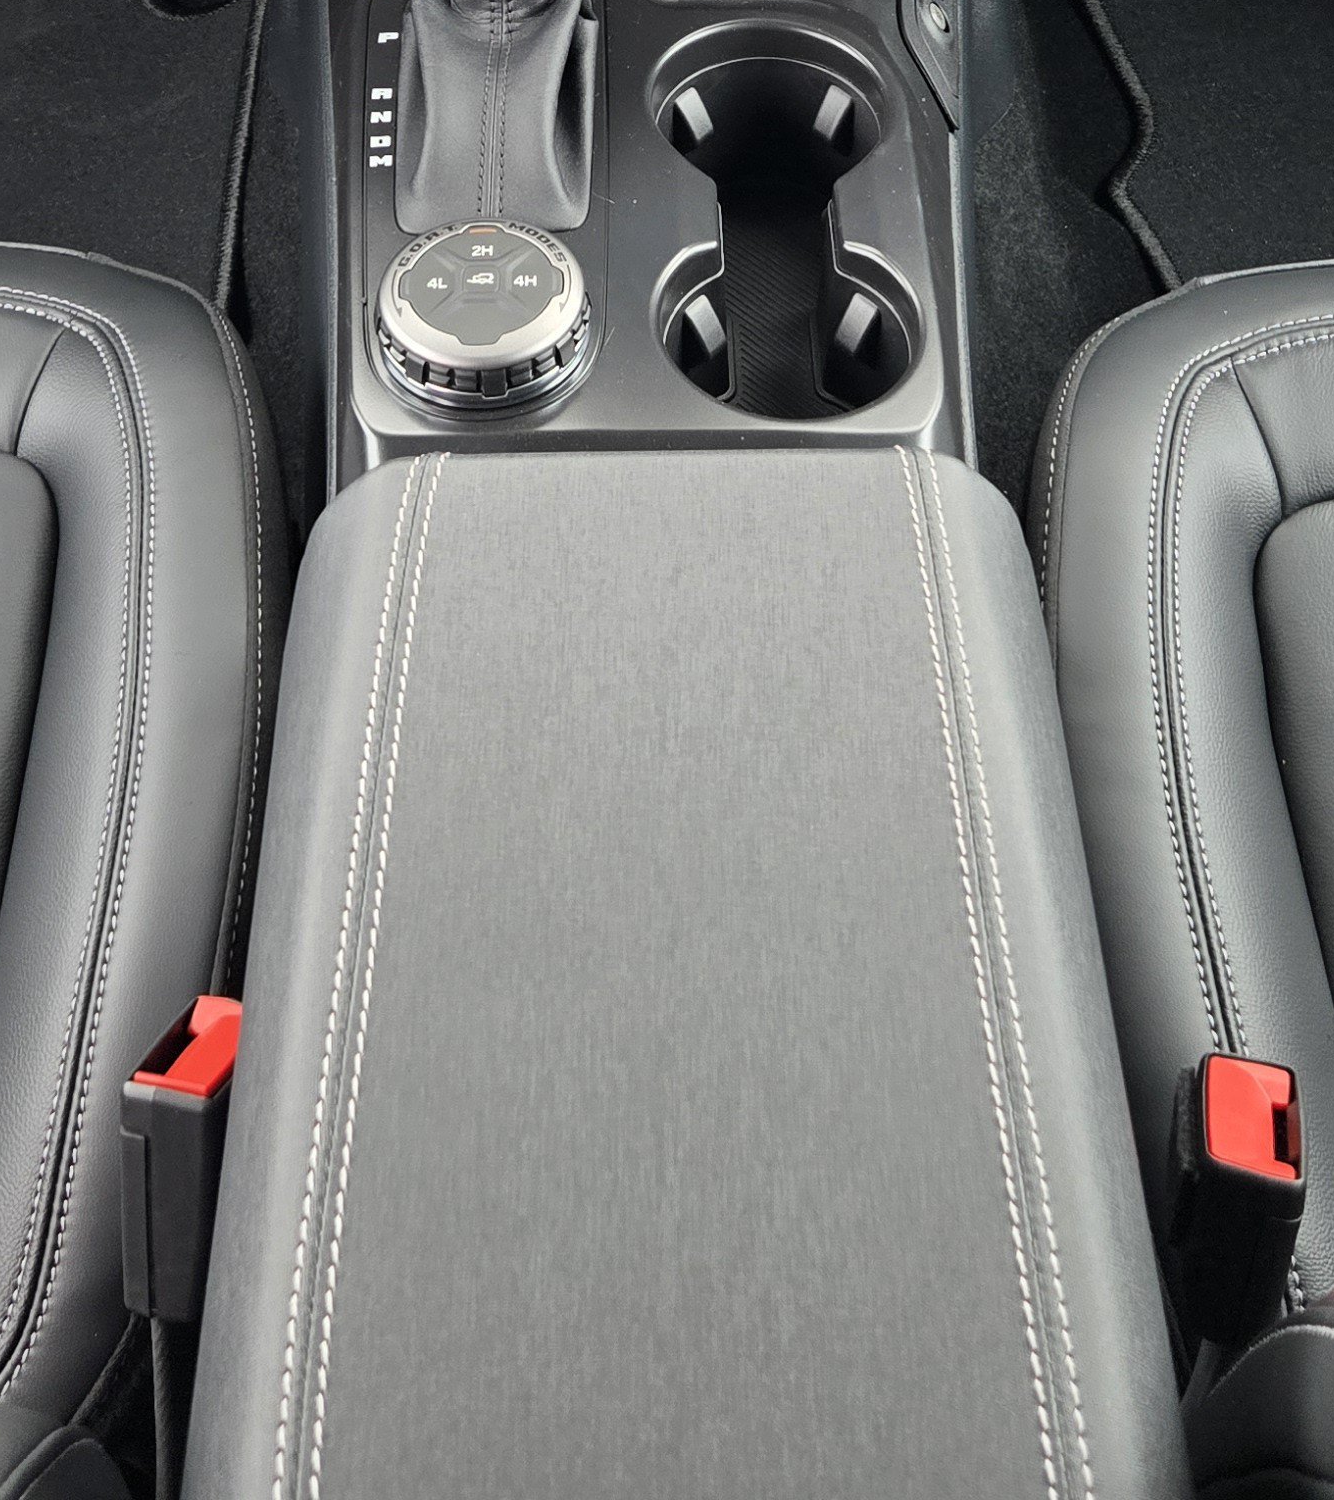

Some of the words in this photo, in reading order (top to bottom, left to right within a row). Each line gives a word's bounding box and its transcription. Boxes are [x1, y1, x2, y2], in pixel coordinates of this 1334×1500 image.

[378, 31, 399, 44] P
[371, 88, 393, 100] R
[370, 111, 392, 123] N
[370, 135, 392, 148] D
[369, 154, 393, 168] M
[508, 223, 567, 262] MODES
[471, 245, 493, 257] 2H
[427, 277, 448, 289] 4L
[514, 275, 537, 287] 4H
